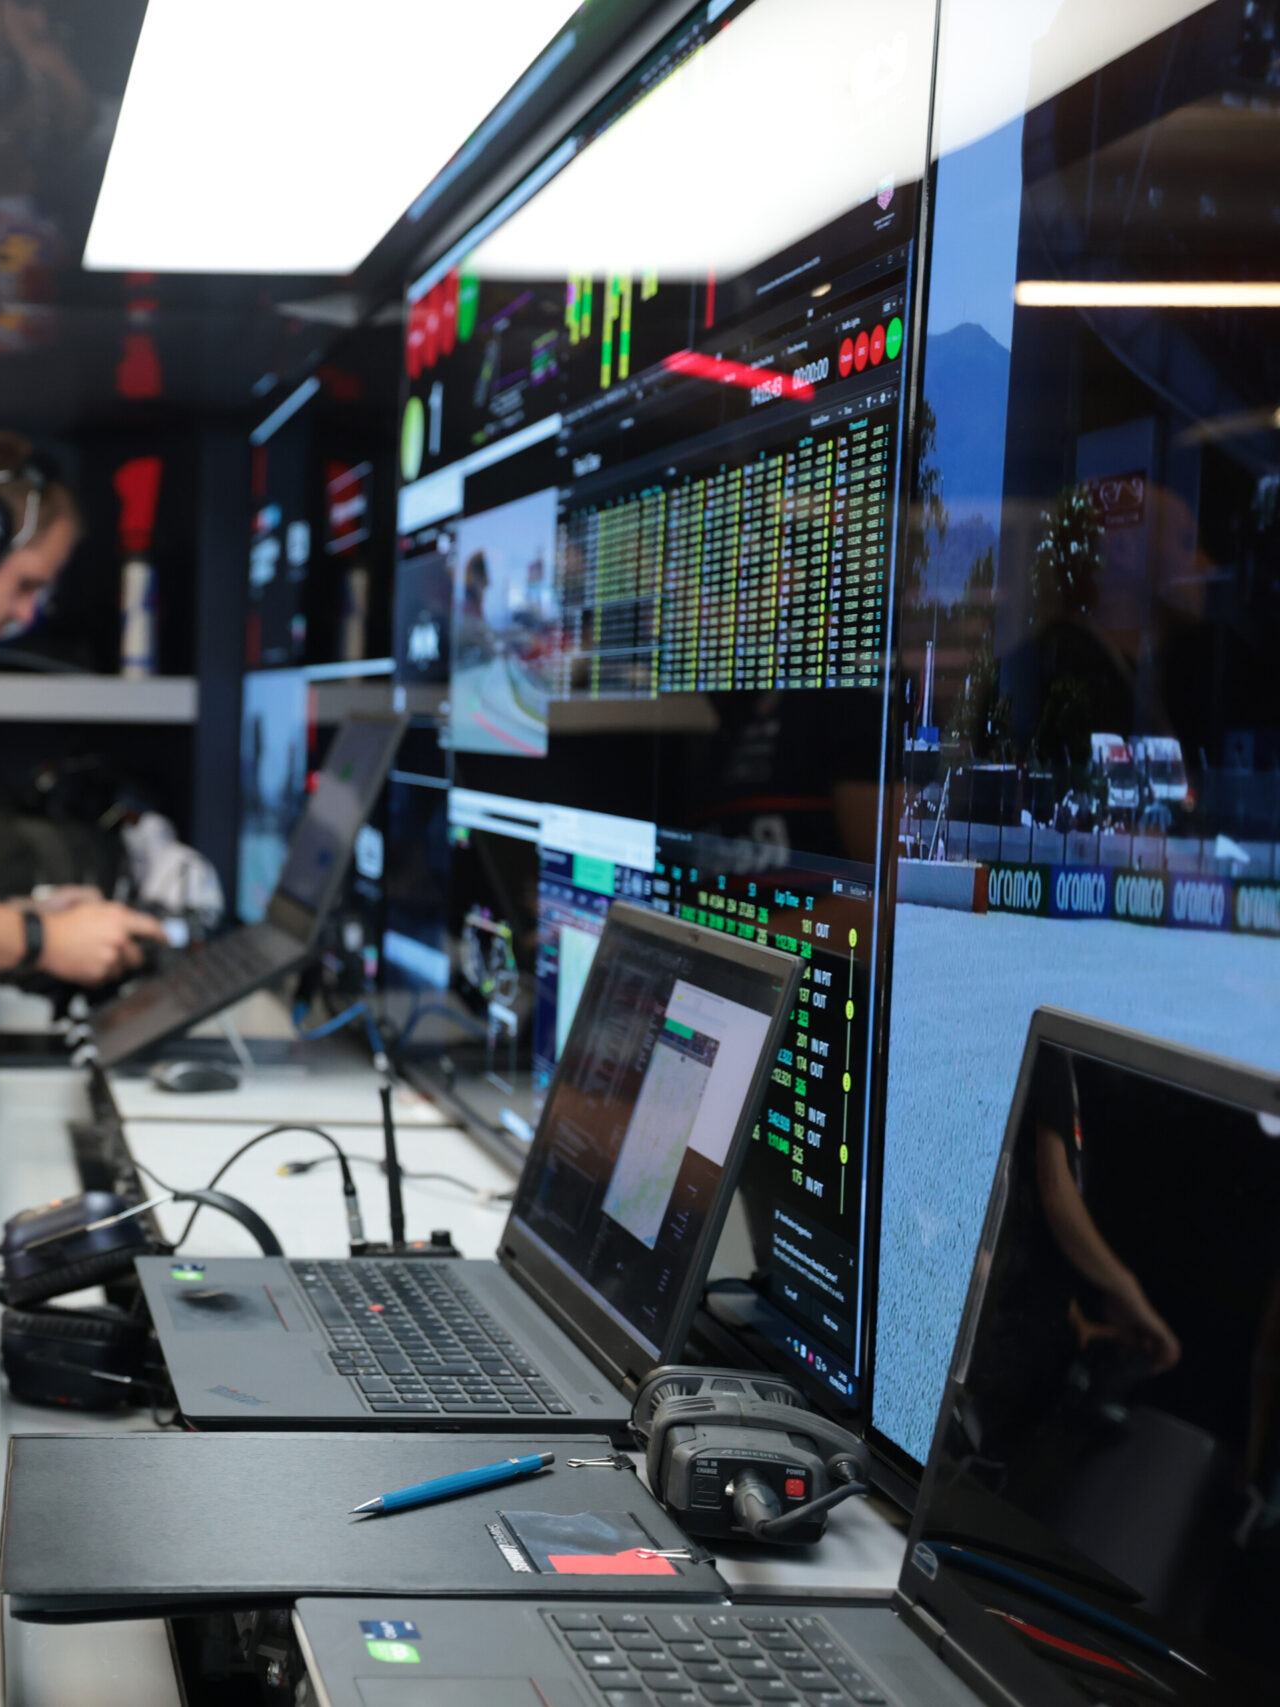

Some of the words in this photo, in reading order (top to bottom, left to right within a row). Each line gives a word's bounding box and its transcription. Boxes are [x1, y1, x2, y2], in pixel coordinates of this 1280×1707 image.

[988, 868, 1041, 910] aramco
[1056, 872, 1105, 913] aramco
[1115, 874, 1164, 919] aramco
[1173, 881, 1225, 925] aramco
[815, 922, 830, 939] OUT
[812, 991, 827, 1009] OUT
[810, 1061, 824, 1079] OUT
[807, 1130, 821, 1148] OUT
[696, 1467, 718, 1475] CHARGE
[786, 1468, 806, 1476] POWER
